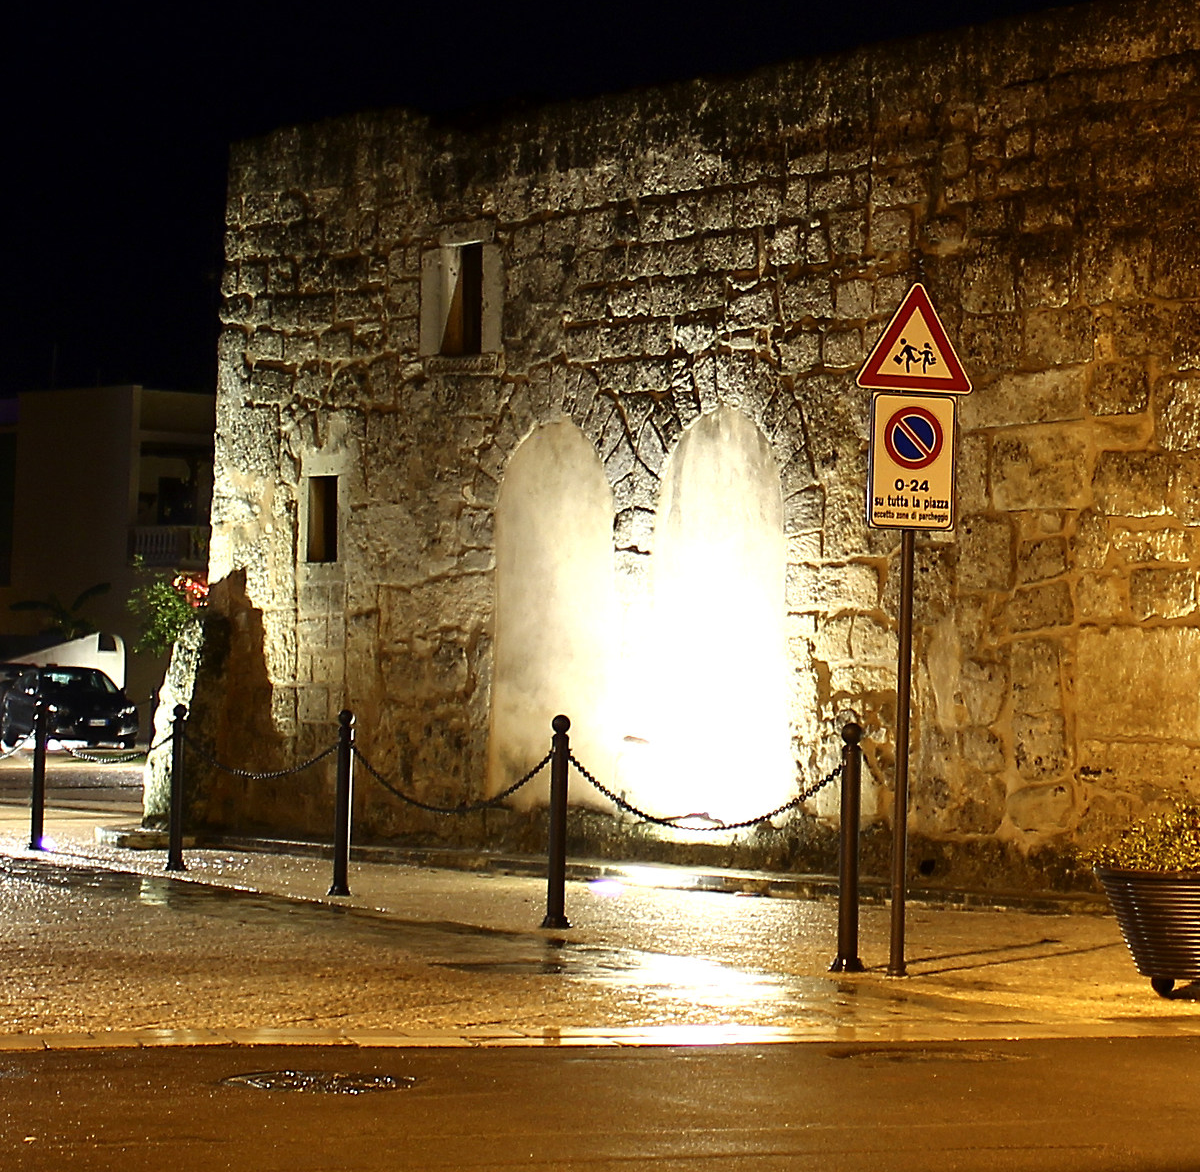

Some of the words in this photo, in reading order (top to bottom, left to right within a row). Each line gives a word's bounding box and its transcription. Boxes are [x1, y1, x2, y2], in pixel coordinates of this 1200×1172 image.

[894, 478, 929, 492] 0-24
[874, 496, 884, 506] su
[887, 494, 908, 507] tutta
[912, 495, 920, 508] la
[924, 496, 949, 511] piazza
[874, 510, 894, 519] eccetto
[911, 511, 917, 519] di
[919, 511, 949, 523] parcheggio
